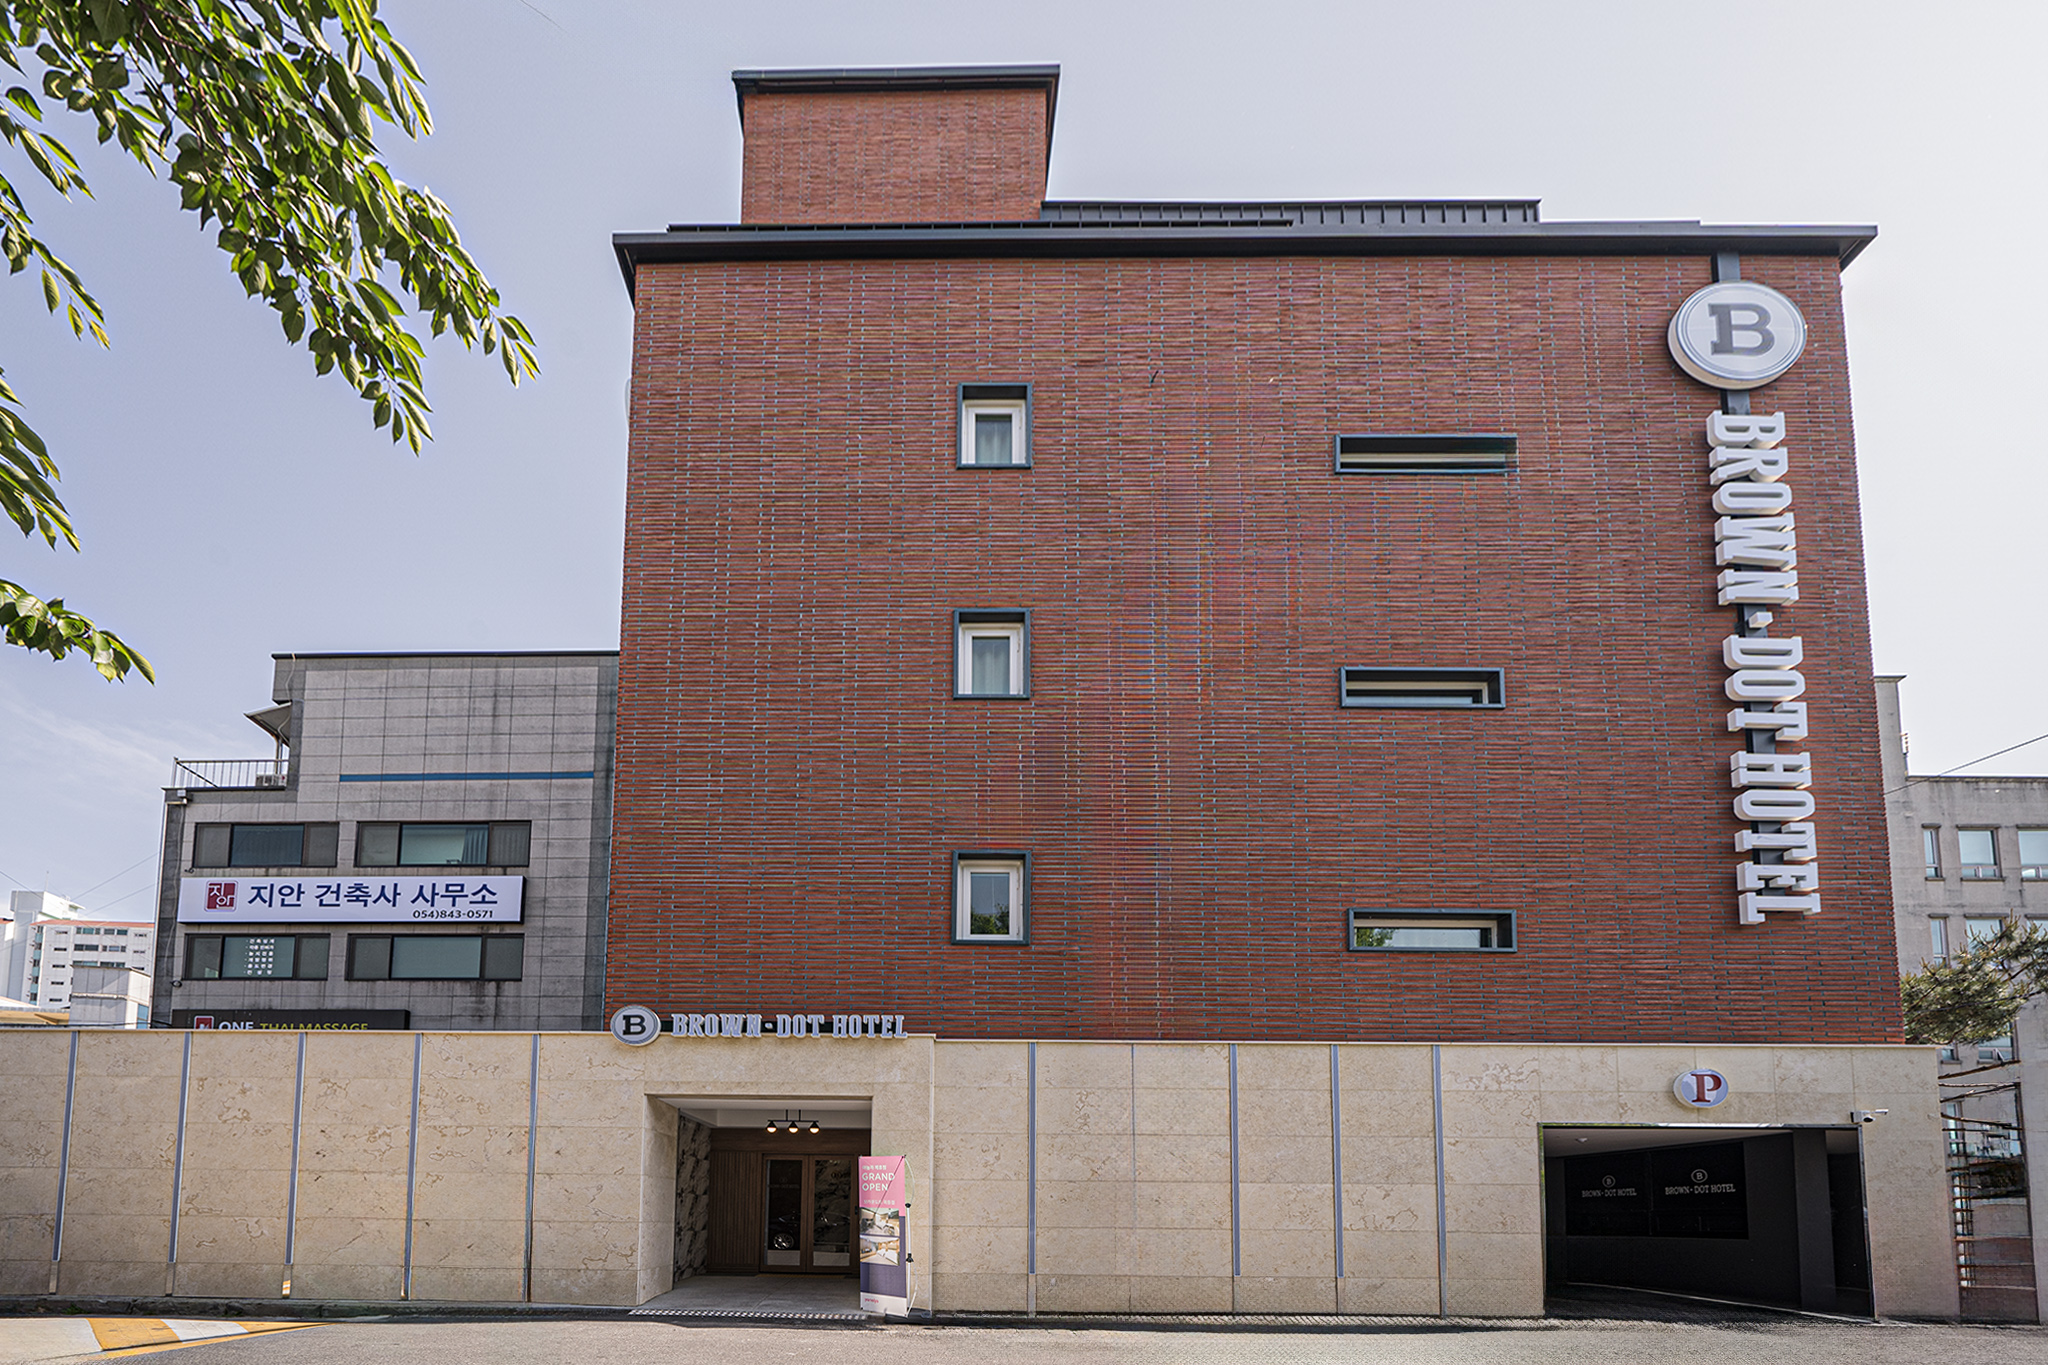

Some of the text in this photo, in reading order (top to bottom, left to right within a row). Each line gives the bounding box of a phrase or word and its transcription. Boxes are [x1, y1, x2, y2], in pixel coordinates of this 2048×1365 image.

[1708, 303, 1775, 357] B
[1730, 750, 1821, 925] HOTEL
[248, 882, 498, 908] 지안 건축사 사무소
[412, 909, 494, 920] 054)843-0571
[219, 1021, 254, 1030] ONE
[622, 1014, 647, 1035] B
[832, 1014, 908, 1038] HOTEL
[1690, 1073, 1722, 1103] P
[862, 1172, 895, 1181] GRAND
[862, 1183, 889, 1192] OPEN
[1617, 1188, 1637, 1197] HOTEL
[1710, 1183, 1736, 1193] HOTEL
